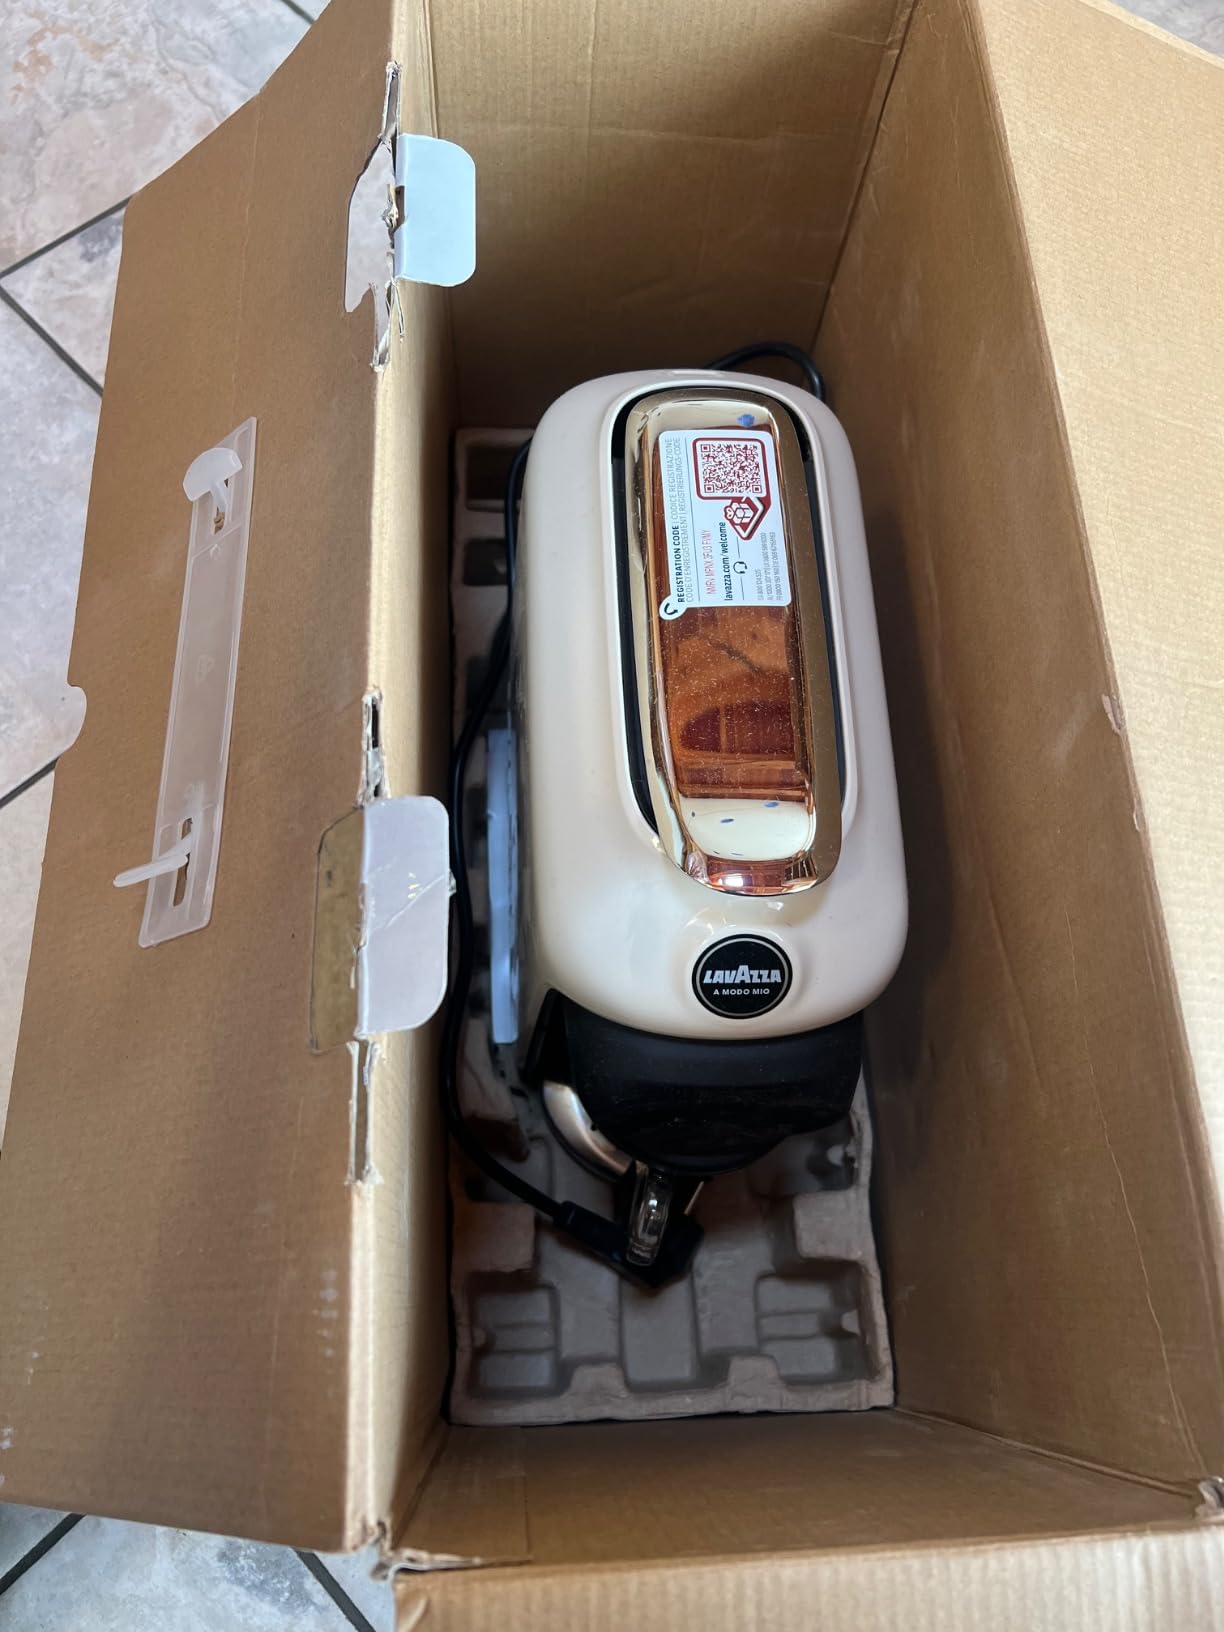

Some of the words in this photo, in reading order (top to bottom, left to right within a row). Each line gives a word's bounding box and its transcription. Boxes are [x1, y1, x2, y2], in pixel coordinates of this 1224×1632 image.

[665, 438, 676, 492] REGISTRAZIONE
[669, 493, 679, 520] CODICE
[672, 525, 681, 546] CODE
[718, 521, 733, 601] lavazza.com/welcome
[673, 548, 685, 602] REGISTRATION
[685, 584, 693, 603] CODE
[703, 964, 782, 984] LAVAZZA
[713, 988, 720, 996] A
[722, 988, 750, 996] MODO
